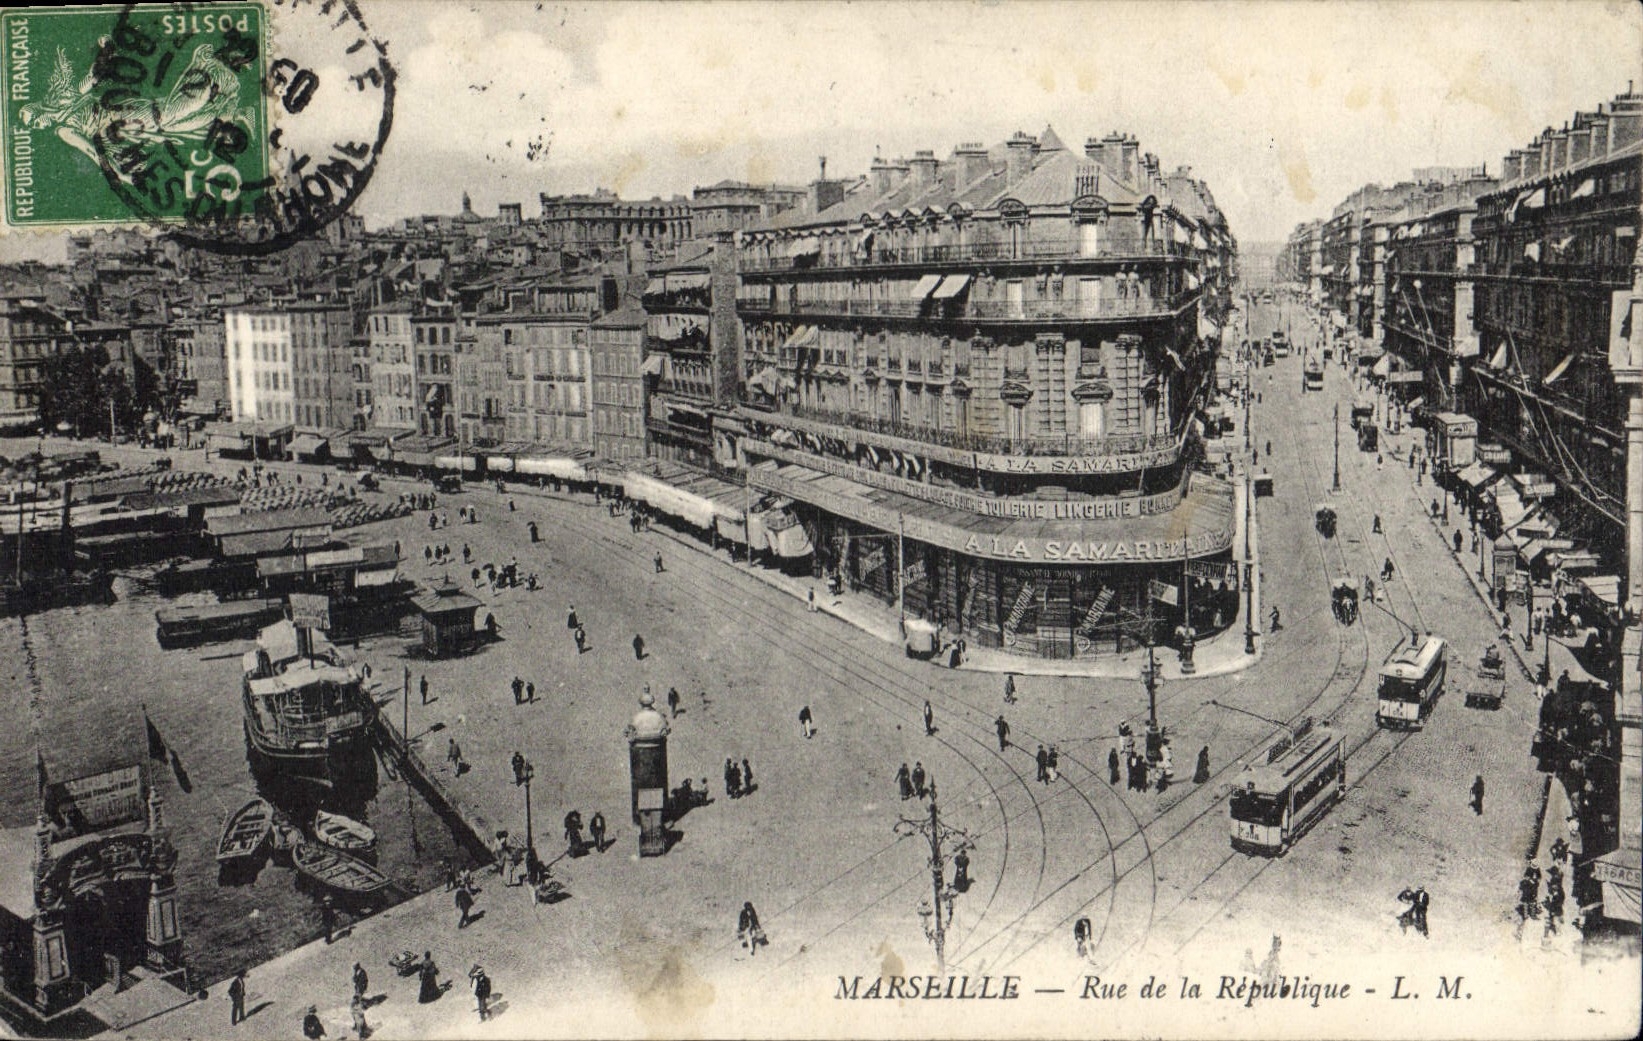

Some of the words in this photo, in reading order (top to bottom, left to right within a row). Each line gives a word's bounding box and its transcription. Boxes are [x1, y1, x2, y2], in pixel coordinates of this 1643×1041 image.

[161, 14, 249, 34] POSTES
[11, 18, 30, 101] FRANÇAISE
[985, 456, 999, 471] A
[1006, 459, 1042, 473] LA
[1054, 501, 1132, 519] LINGERIE
[965, 534, 983, 554] A
[991, 538, 1032, 559] LA
